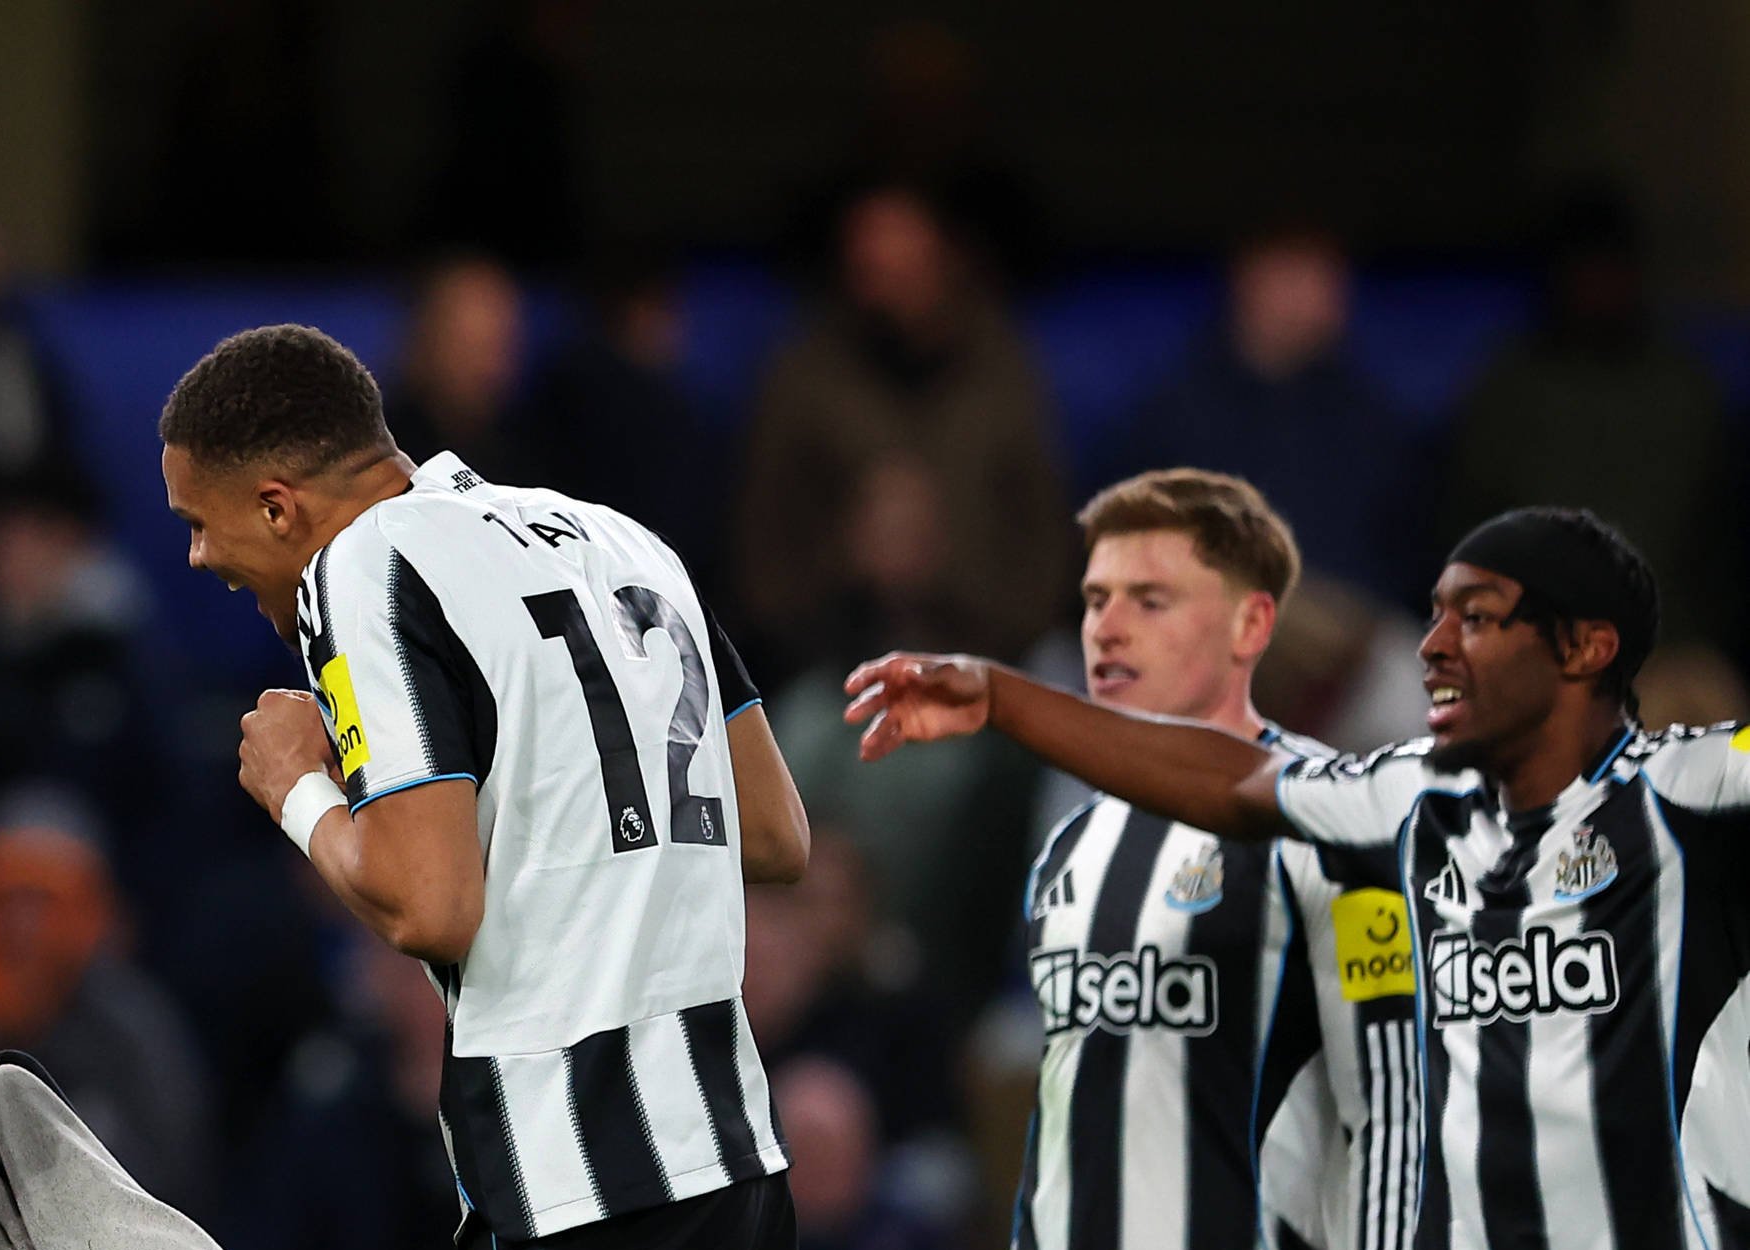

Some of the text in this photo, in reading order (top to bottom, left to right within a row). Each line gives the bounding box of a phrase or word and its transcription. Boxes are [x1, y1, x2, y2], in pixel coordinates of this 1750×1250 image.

[453, 478, 477, 494] THE
[521, 585, 728, 855] 12
[1345, 951, 1412, 984] noo
